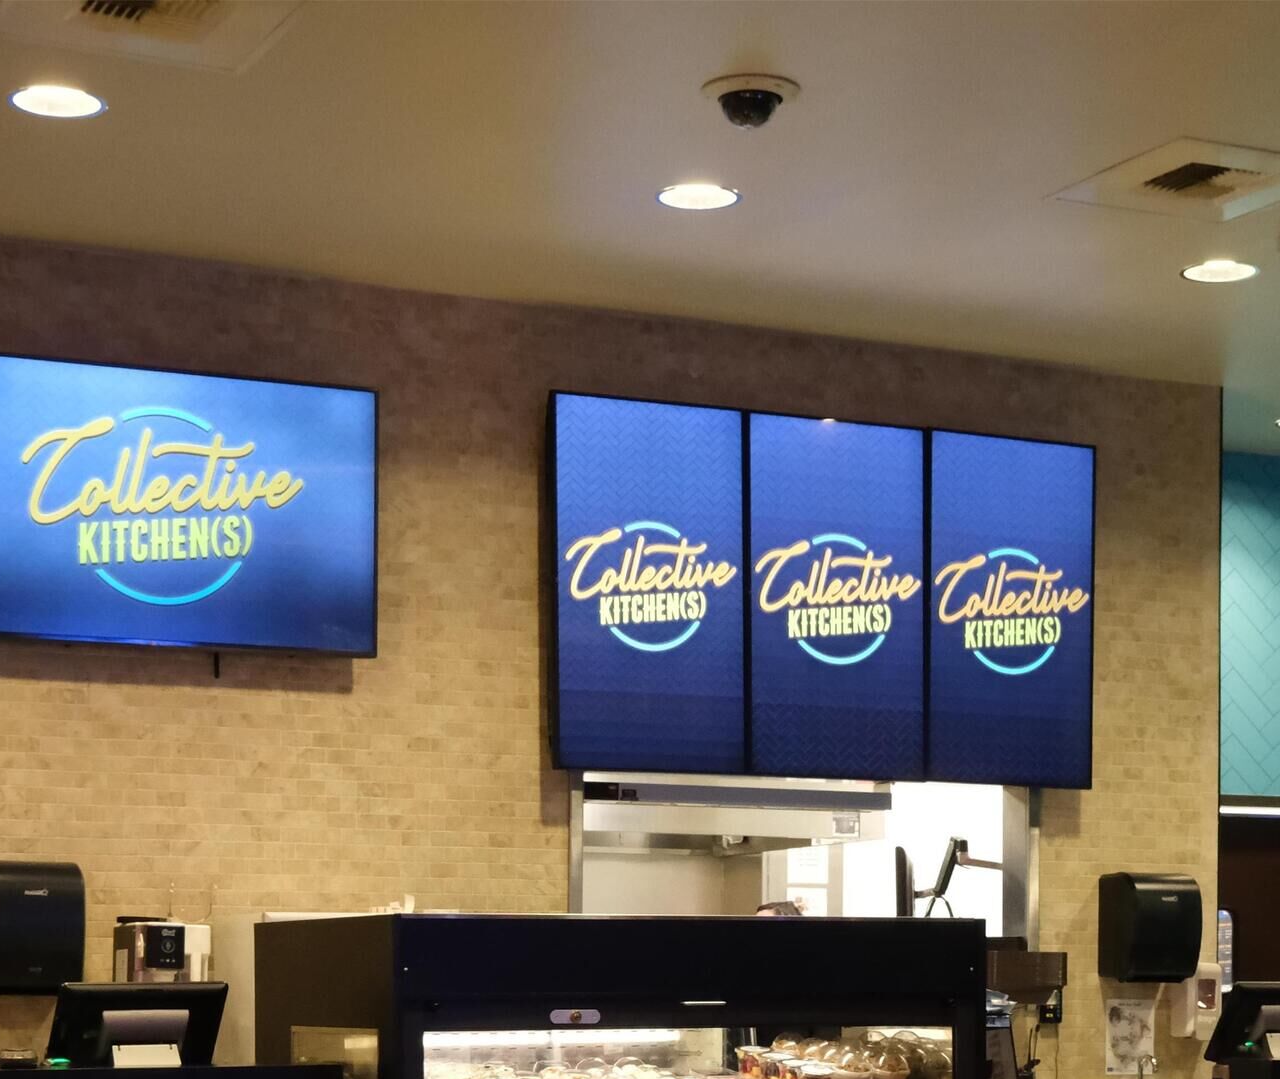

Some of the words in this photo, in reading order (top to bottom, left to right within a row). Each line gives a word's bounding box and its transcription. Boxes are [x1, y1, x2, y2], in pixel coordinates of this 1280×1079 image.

[21, 416, 305, 525] Collective
[78, 514, 254, 565] KITCHEN(S)
[564, 527, 737, 601] Collective
[755, 540, 922, 613] Collective
[934, 554, 1089, 625] Collective
[599, 590, 707, 626] KITCHEN(S)
[787, 602, 892, 640] KITCHEN(S)
[964, 615, 1061, 649] KITCHEN(S)
